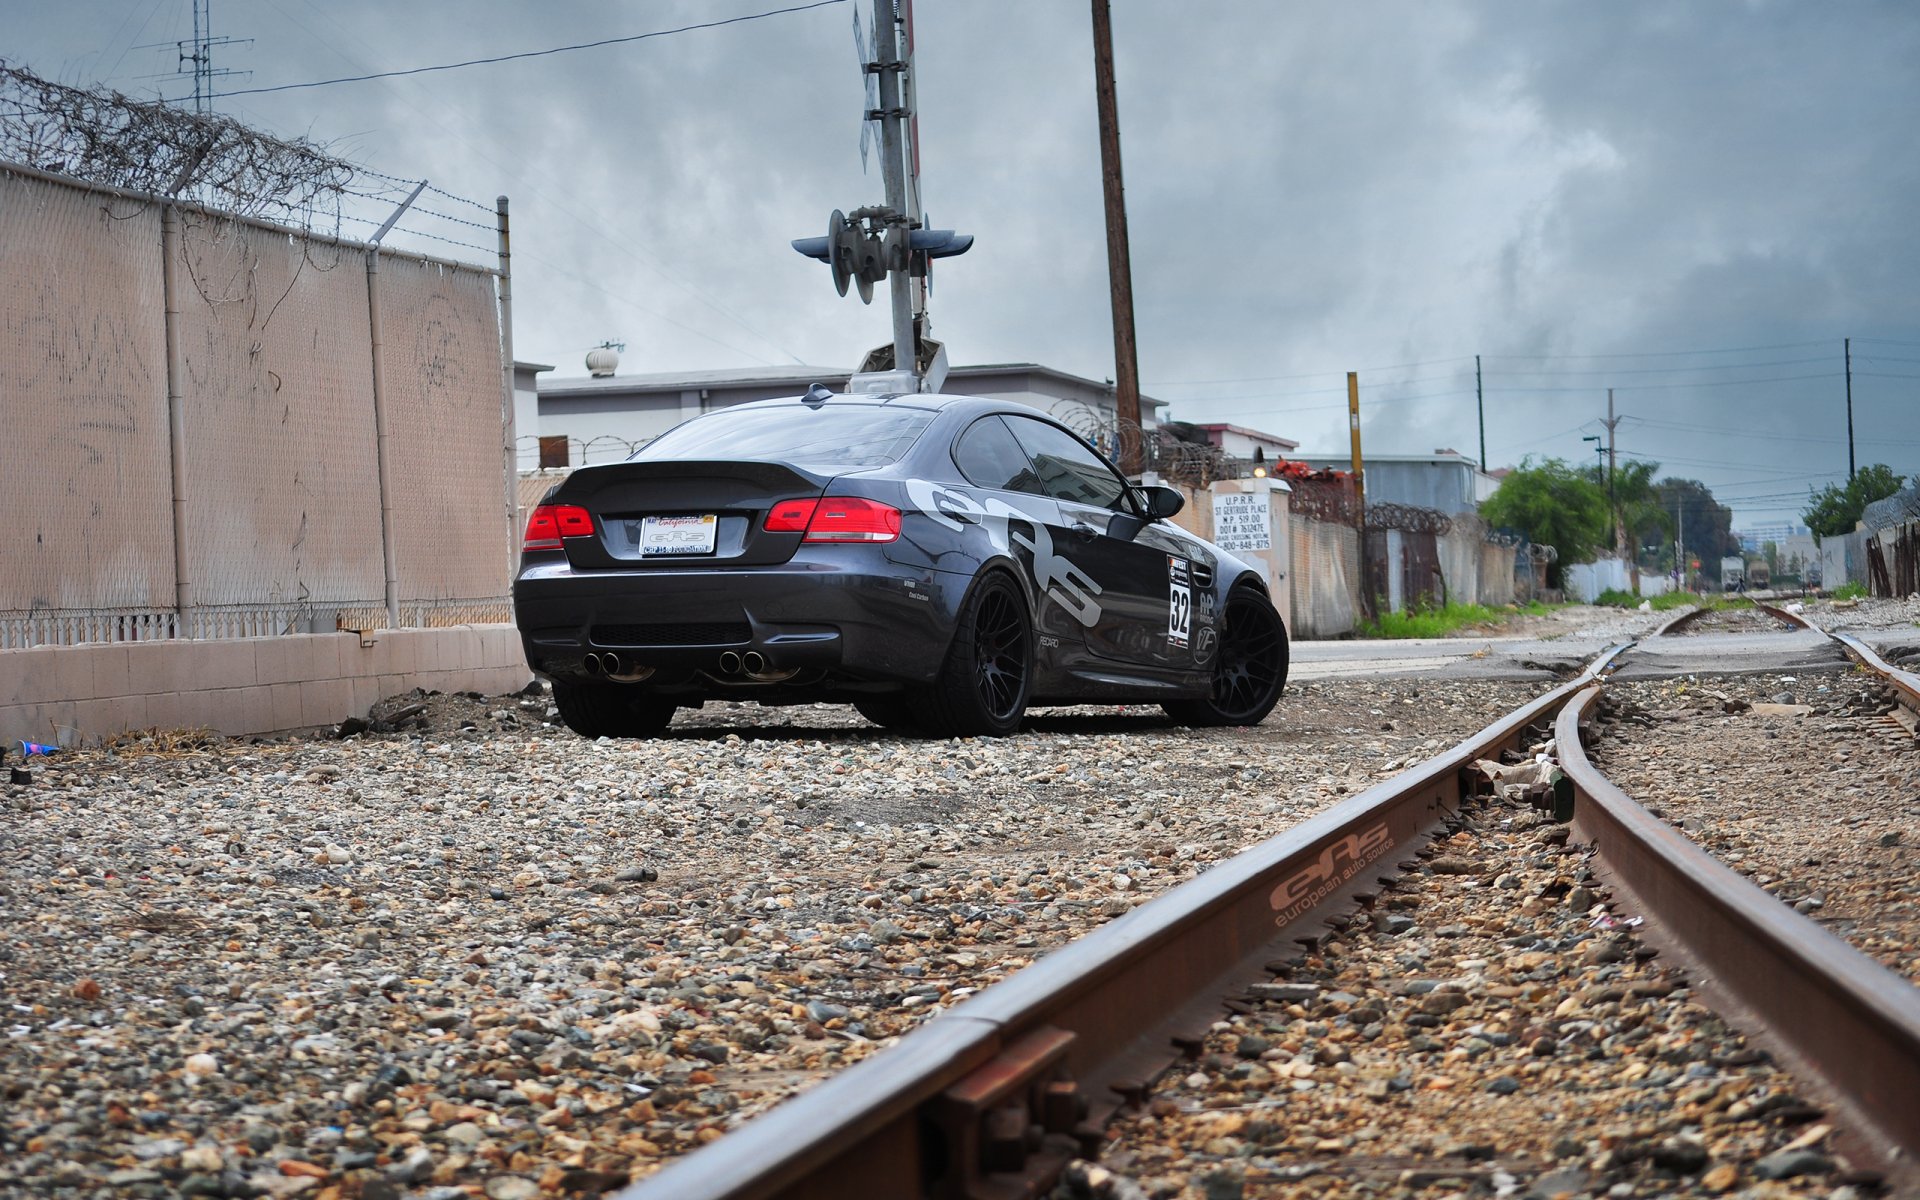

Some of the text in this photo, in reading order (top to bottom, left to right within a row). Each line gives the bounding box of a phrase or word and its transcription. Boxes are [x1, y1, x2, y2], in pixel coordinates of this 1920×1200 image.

[1226, 496, 1255, 505] U.P.R.R.
[1223, 506, 1248, 515] GERTRUDE
[1251, 504, 1266, 513] PLACE
[659, 519, 702, 528] California
[1171, 590, 1189, 633] 32
[1040, 635, 1059, 648] RECARO
[1275, 838, 1395, 927] european auto source
